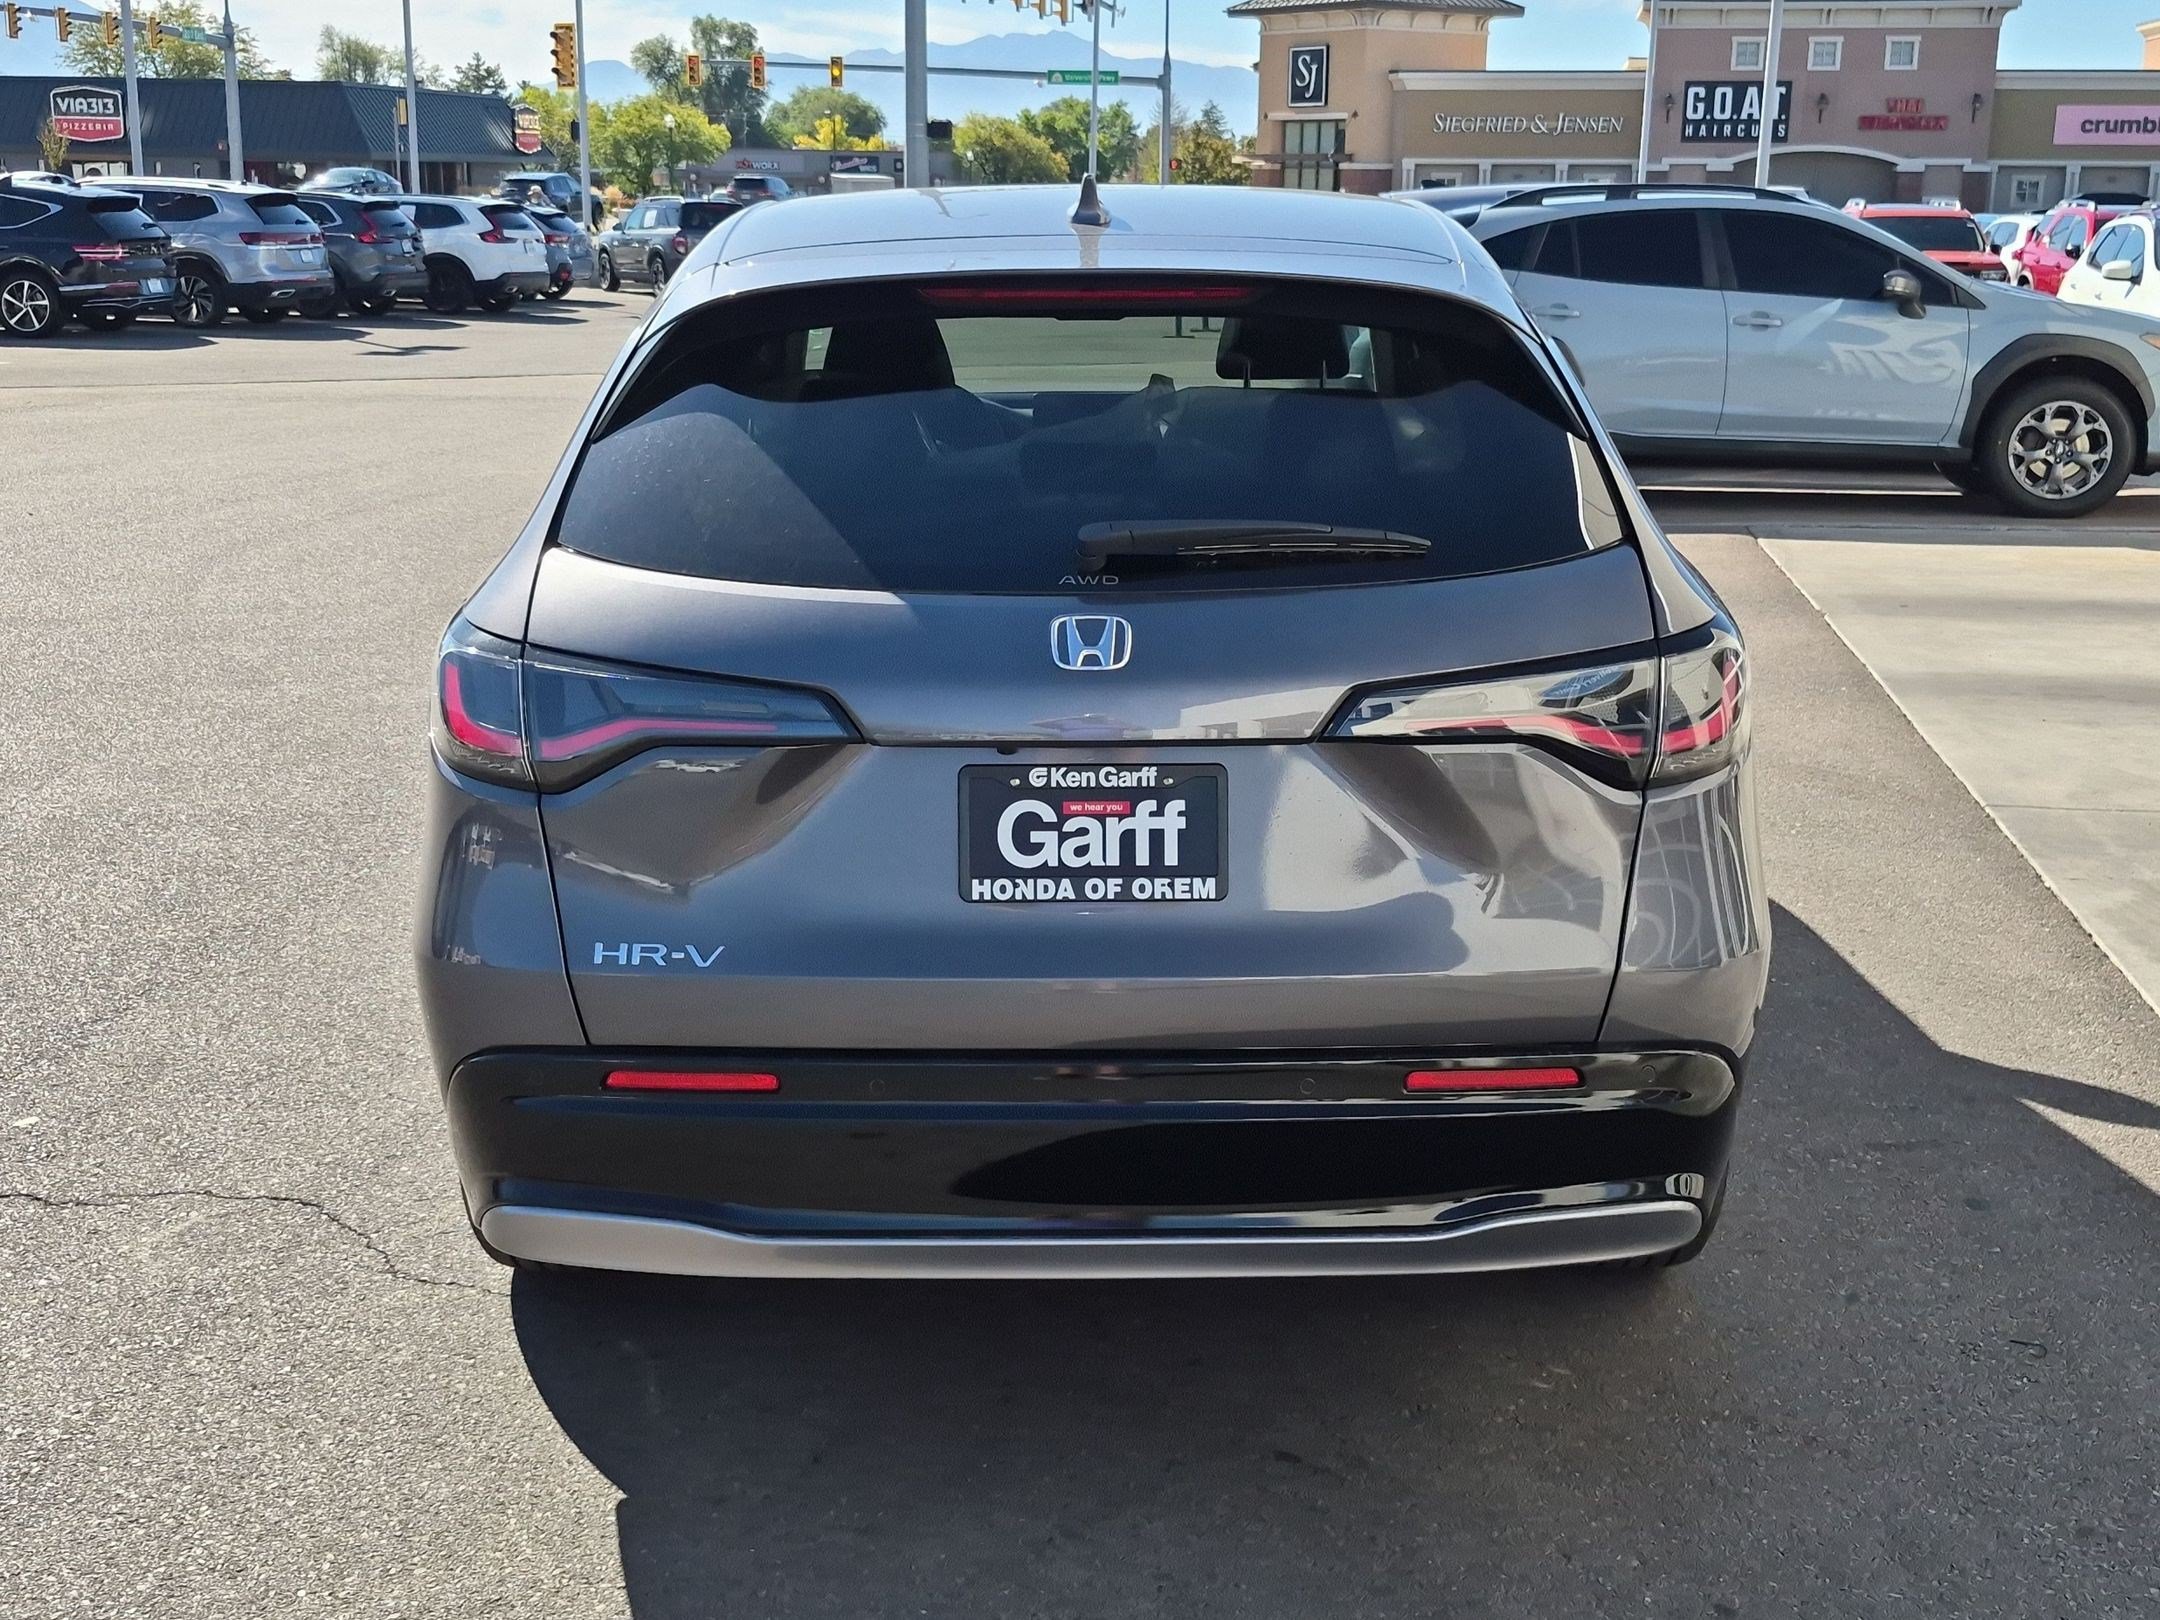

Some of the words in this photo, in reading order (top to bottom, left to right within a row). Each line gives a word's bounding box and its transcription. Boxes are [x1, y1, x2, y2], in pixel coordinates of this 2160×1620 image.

[1295, 55, 1318, 98] SJ
[62, 122, 114, 131] PIZZERIA
[1433, 112, 1526, 133] SIEGFRIED
[1530, 113, 1549, 133] &
[1553, 112, 1624, 136] JENSEN
[1684, 124, 1786, 137] HAIRCUS
[1058, 575, 1119, 586] AWD
[1051, 766, 1096, 788] Ken
[1098, 765, 1158, 788] Garff
[1070, 803, 1083, 812] we
[1084, 801, 1104, 812] hear
[1106, 804, 1124, 815] you
[997, 799, 1186, 869] Garff
[971, 878, 1076, 901] HONDA
[1084, 878, 1122, 900] OF
[1131, 878, 1216, 900] OREM
[593, 942, 726, 968] HR-V
